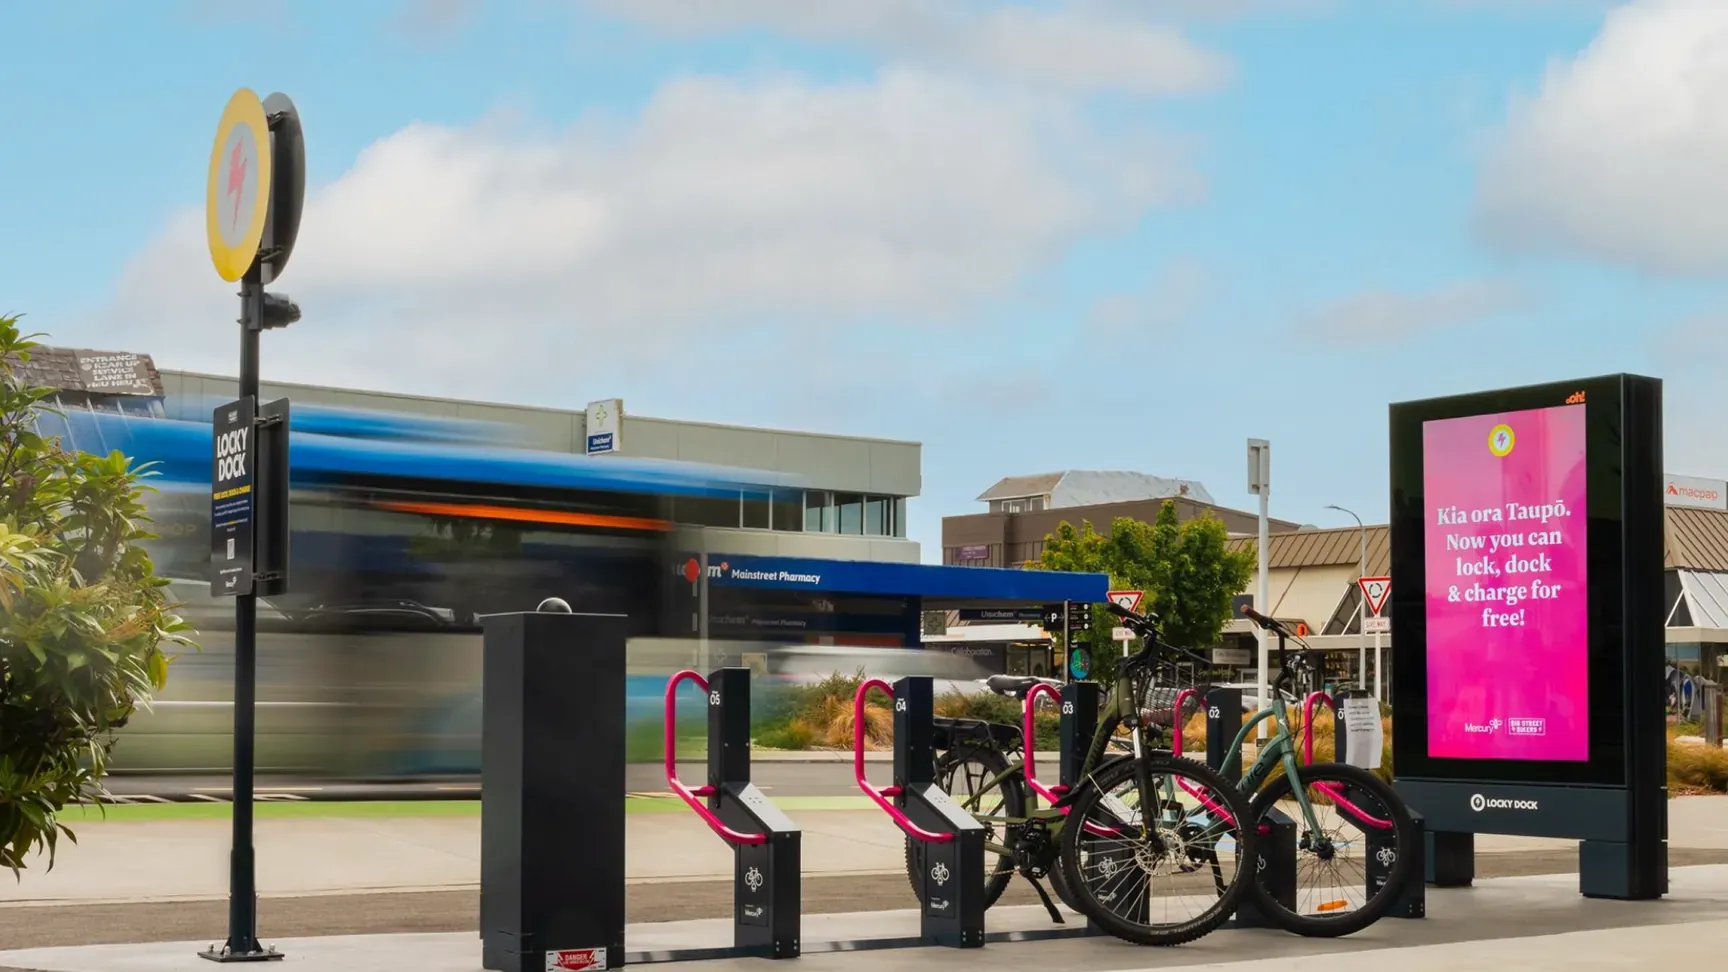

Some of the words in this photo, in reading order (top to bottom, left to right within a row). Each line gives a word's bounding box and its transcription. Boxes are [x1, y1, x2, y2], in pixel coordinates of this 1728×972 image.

[217, 426, 249, 458] LOCKY
[218, 452, 246, 482] DOCK
[1437, 505, 1468, 525] Kia
[1471, 507, 1503, 523] ora
[1505, 499, 1571, 523] Taupō.
[1446, 533, 1487, 551] Now
[1489, 532, 1525, 553] you
[1528, 530, 1563, 546] can
[1456, 556, 1502, 577] lock,
[1505, 552, 1553, 574] dock
[731, 569, 778, 581] Mainstreet
[778, 571, 821, 584] Pharmacy
[1447, 585, 1462, 602] &
[1464, 582, 1528, 606] charge
[1531, 579, 1562, 599] for
[1051, 613, 1058, 623] P
[1482, 607, 1525, 627] free!
[709, 694, 720, 705] 05
[895, 701, 907, 712] 04
[1062, 704, 1074, 714] 03
[1208, 709, 1220, 719] 02
[1464, 723, 1494, 735] Mercury
[1486, 799, 1513, 808] LOCKY
[1514, 801, 1538, 810] DOCK
